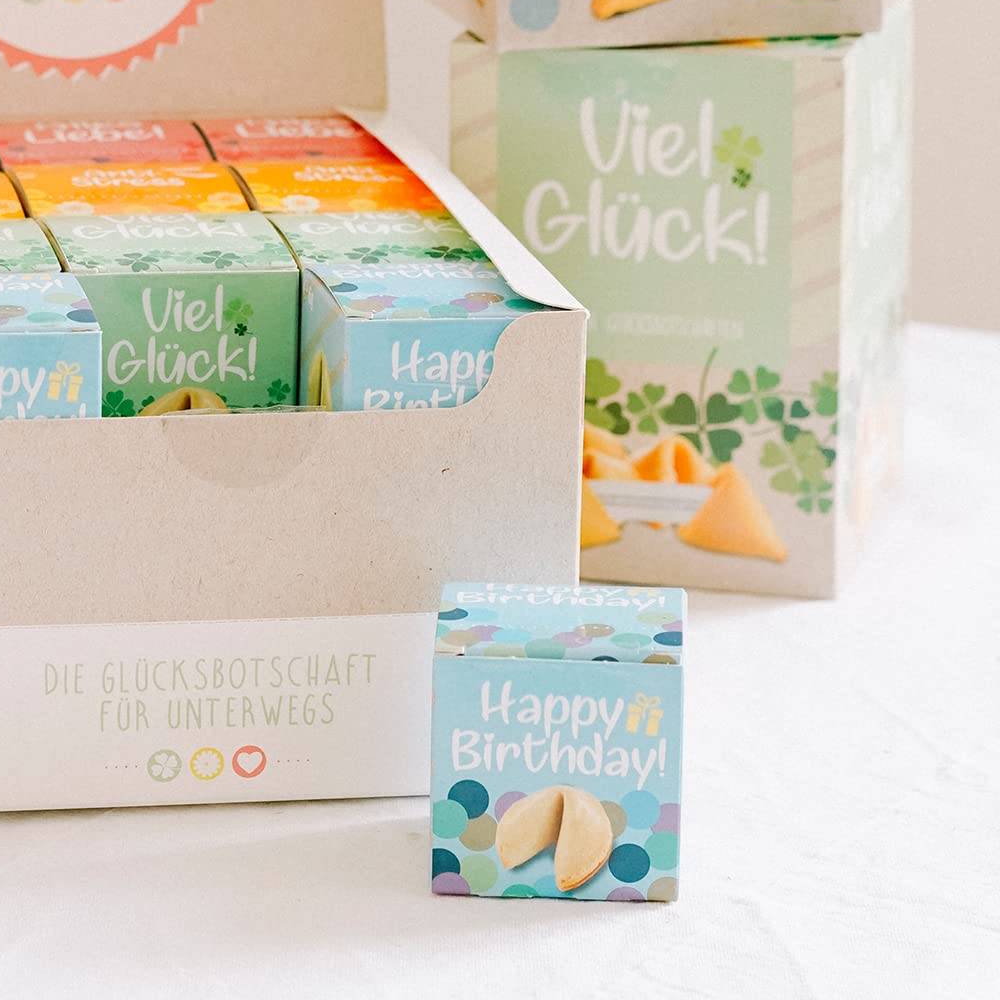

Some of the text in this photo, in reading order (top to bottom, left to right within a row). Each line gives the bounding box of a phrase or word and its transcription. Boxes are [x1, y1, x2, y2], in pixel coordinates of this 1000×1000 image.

[236, 119, 366, 138] Liebe
[580, 97, 714, 179] Viel
[73, 221, 248, 239] Glück!
[301, 218, 465, 235] Glück
[523, 178, 770, 267] Glück!
[142, 284, 224, 333] Viel
[107, 335, 258, 385] Glück!
[391, 338, 496, 392] Happ
[456, 591, 665, 612] Birthday!
[44, 653, 377, 695] DIE GLÜCKSBOTSCHAFT
[99, 692, 336, 734] FÜR UNTERWEGS
[480, 680, 626, 740] Happy
[451, 729, 668, 794] Birthday!
